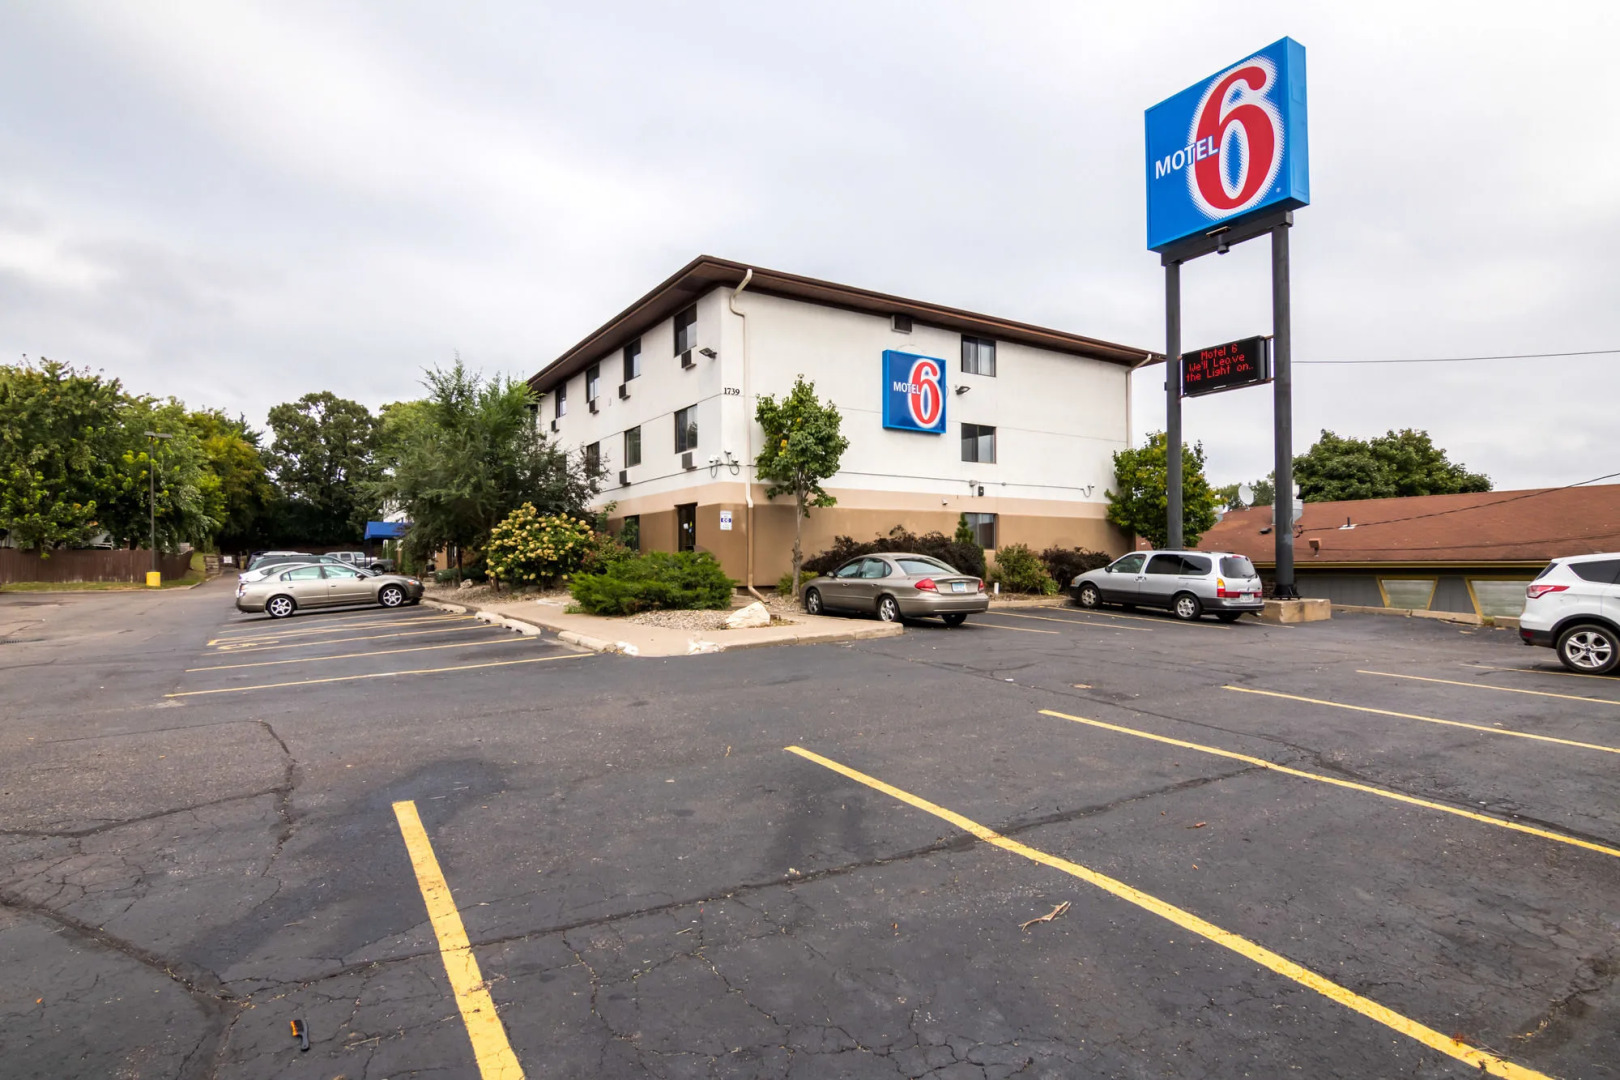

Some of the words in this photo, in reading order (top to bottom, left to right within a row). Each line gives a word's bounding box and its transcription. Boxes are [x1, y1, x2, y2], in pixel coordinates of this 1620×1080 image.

[1155, 135, 1220, 180] MOTEL
[1193, 65, 1276, 211] 6
[1201, 346, 1226, 360] Motel
[1231, 343, 1238, 353] 6
[1188, 360, 1208, 372] We'll
[1213, 353, 1245, 368] Leave
[1186, 373, 1202, 382] the
[1206, 365, 1230, 378] Light
[723, 387, 741, 396] 1739
[893, 381, 921, 395] MOTEL
[911, 360, 941, 425] 6
